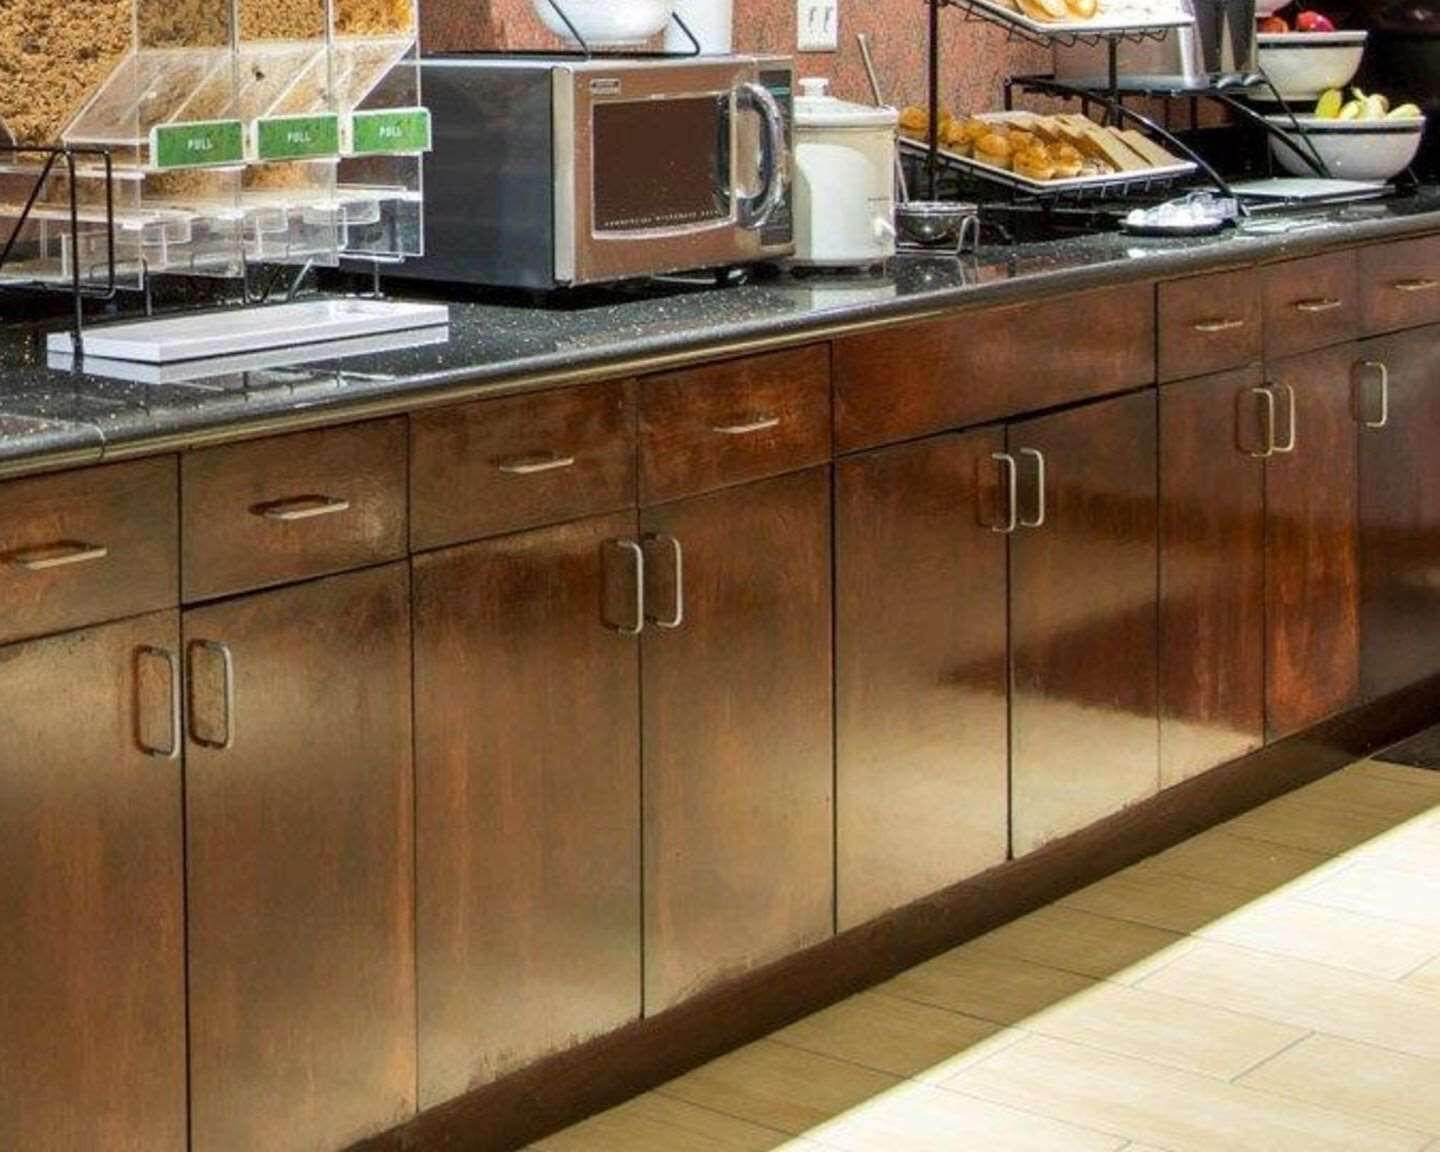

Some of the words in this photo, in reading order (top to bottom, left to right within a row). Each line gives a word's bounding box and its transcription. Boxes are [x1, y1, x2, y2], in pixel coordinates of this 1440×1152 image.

[288, 132, 311, 143] PULL
[379, 126, 402, 138] PULL
[187, 138, 212, 150] PULL
